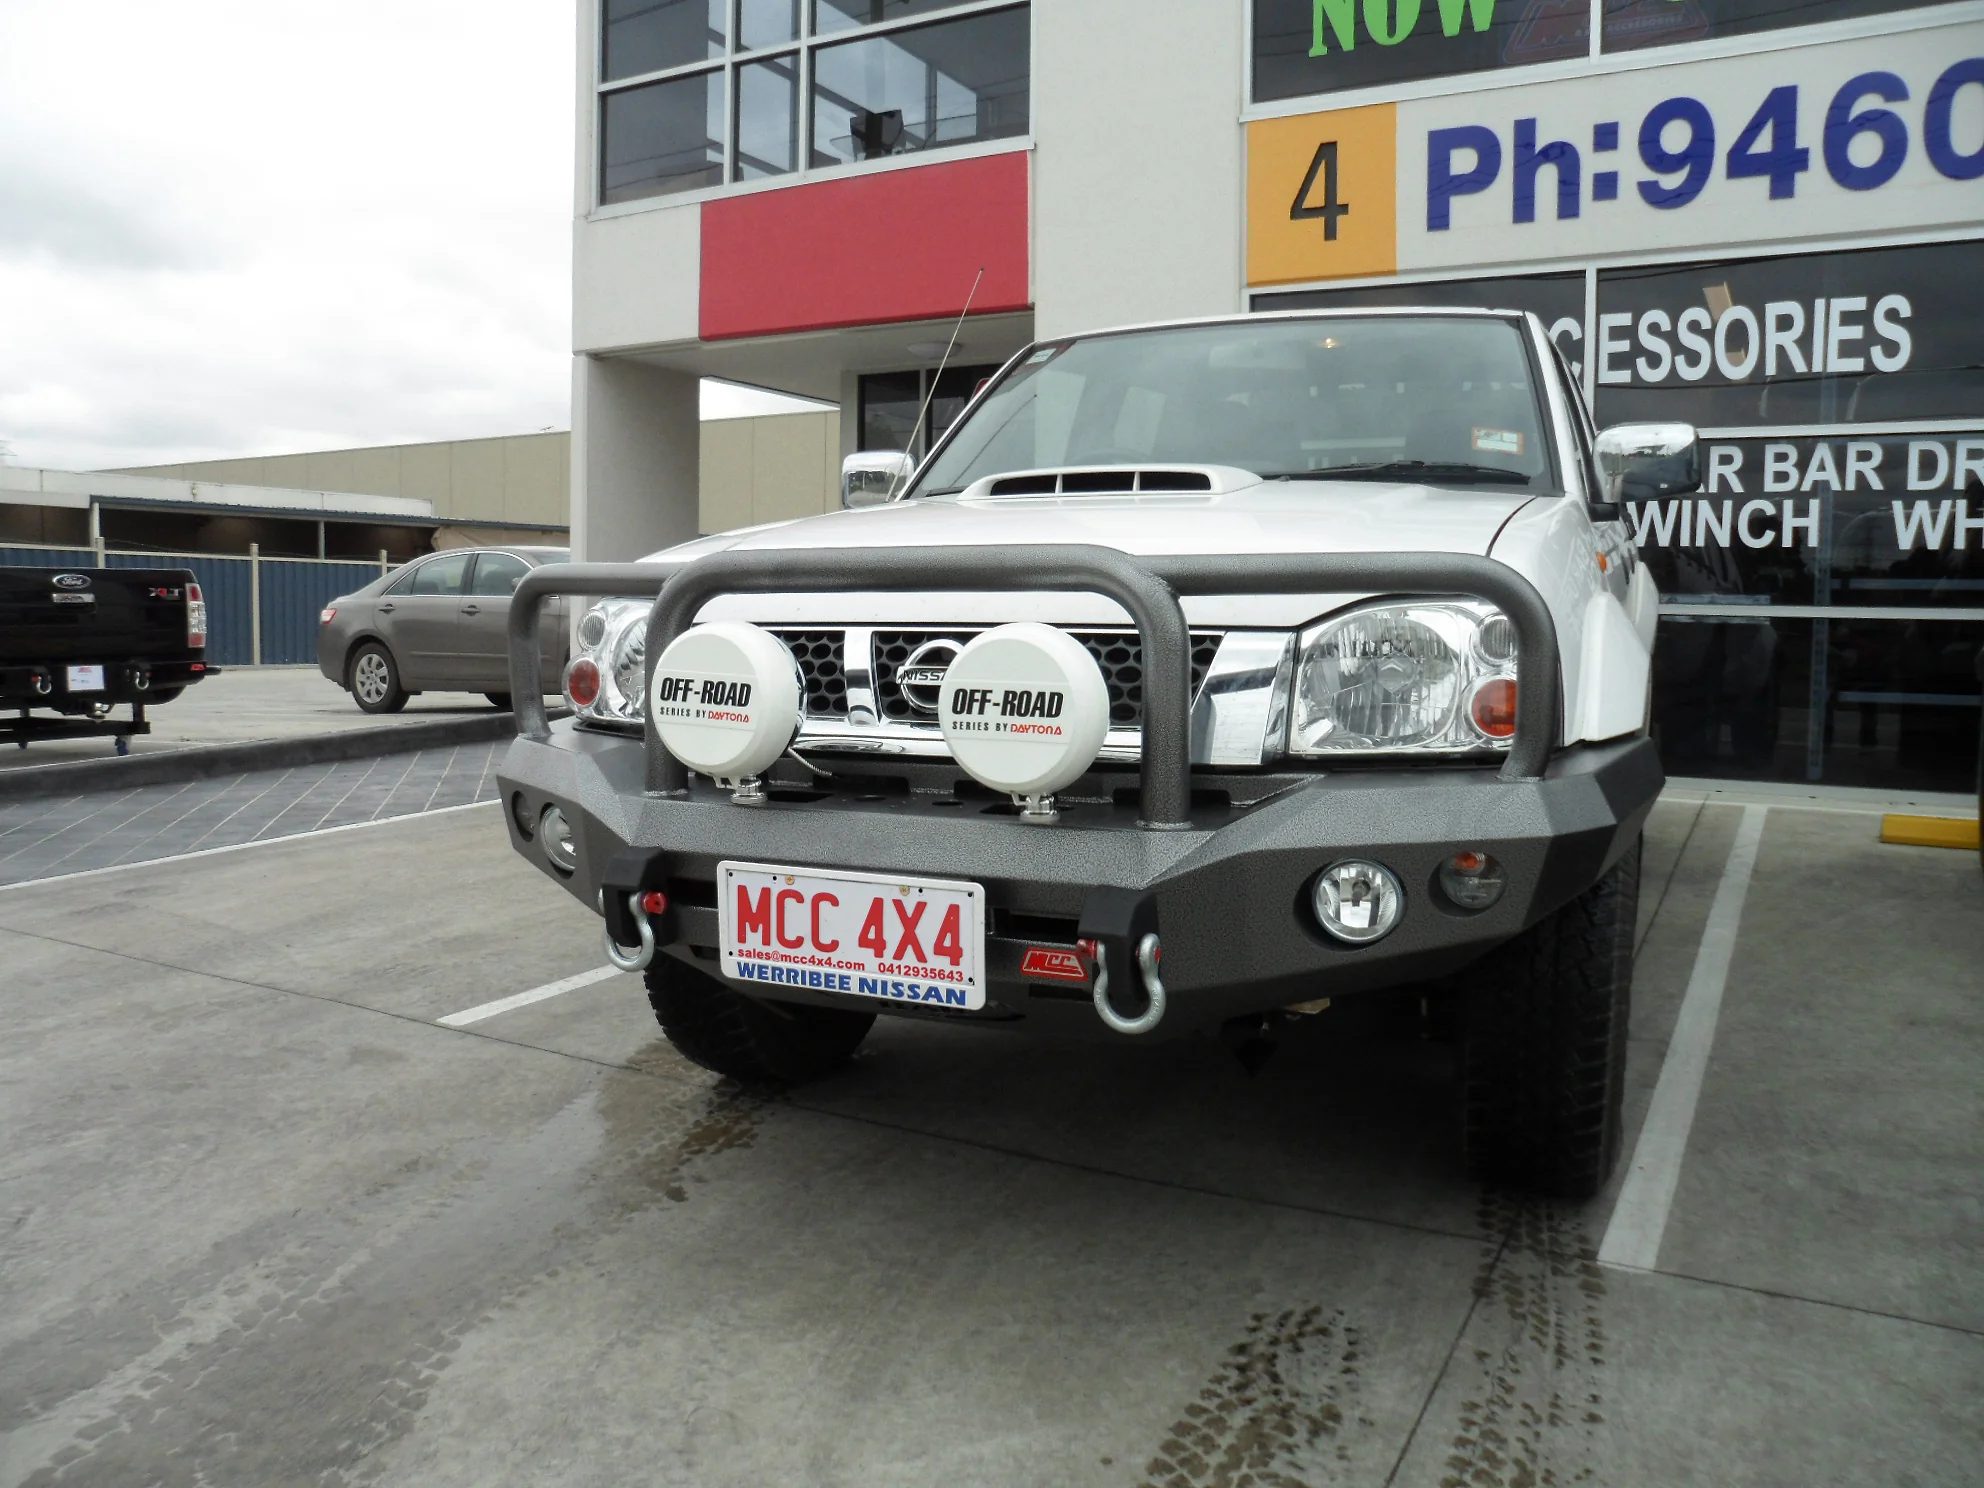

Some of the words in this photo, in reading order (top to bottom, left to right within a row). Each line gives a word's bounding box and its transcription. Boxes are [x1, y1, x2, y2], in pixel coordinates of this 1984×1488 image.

[1308, 0, 1496, 57] NOW
[1290, 140, 1349, 241] 4
[1764, 441, 1884, 492] BAR
[1627, 499, 1820, 549] WINCH
[660, 677, 752, 707] OFF-ROAD
[902, 669, 947, 681] NISS
[660, 706, 691, 717] SERIES
[696, 709, 706, 718] BY
[708, 711, 750, 723] DAYTONA
[952, 688, 1064, 718] OFF-ROAD
[952, 721, 989, 731] SERIES
[996, 723, 1008, 732] BY
[1010, 723, 1063, 735] DAYTONA
[737, 884, 840, 953] MCC
[858, 896, 964, 966] 4X4
[737, 948, 865, 971] sales@mcc4x4.com
[878, 962, 964, 983] 0412935643
[737, 961, 852, 990] WERRIBEE
[858, 976, 967, 1006] NISSAN
